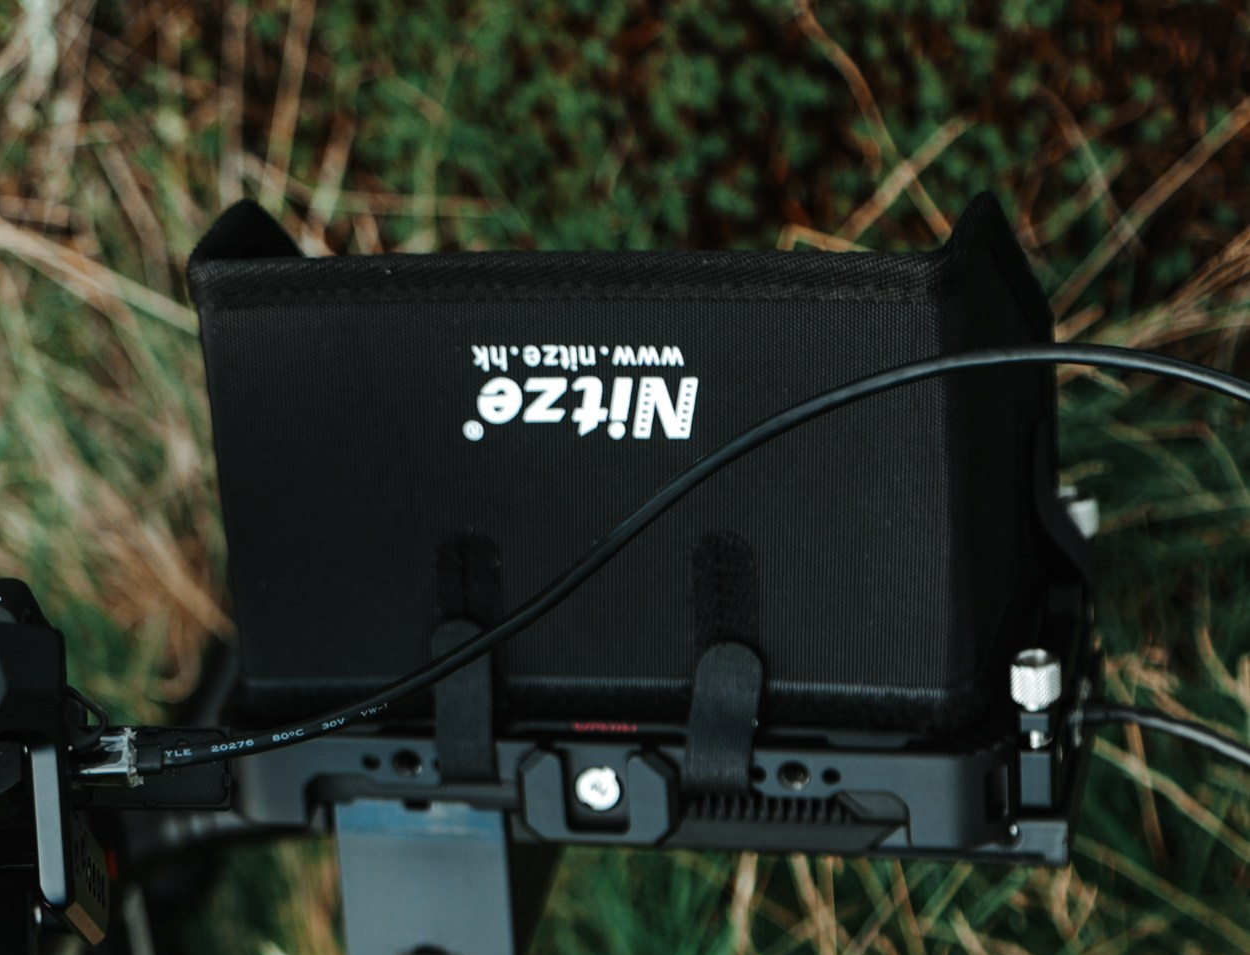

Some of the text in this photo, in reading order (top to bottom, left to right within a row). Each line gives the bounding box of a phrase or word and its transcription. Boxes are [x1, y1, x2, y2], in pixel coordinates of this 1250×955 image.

[471, 345, 685, 372] www.nitze.hk
[211, 738, 255, 753] 20276
[321, 717, 346, 731] 30V
